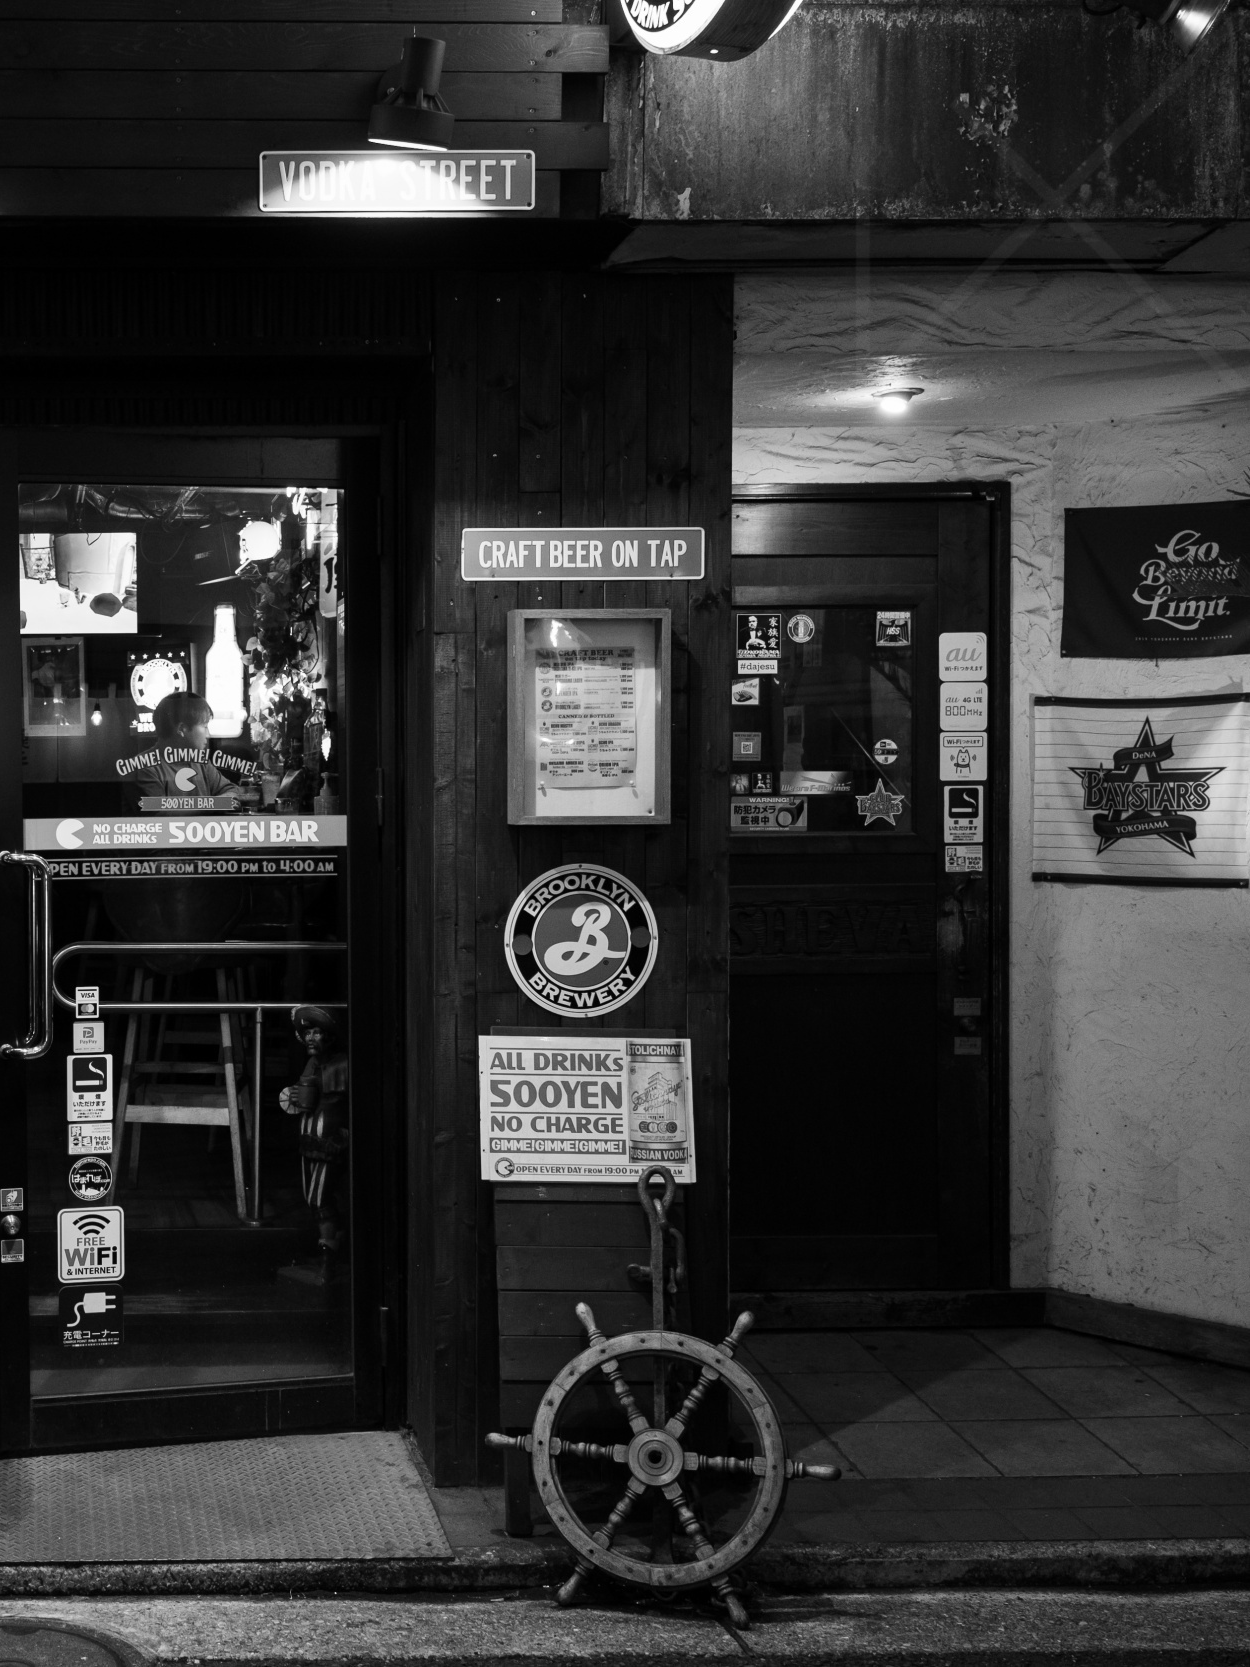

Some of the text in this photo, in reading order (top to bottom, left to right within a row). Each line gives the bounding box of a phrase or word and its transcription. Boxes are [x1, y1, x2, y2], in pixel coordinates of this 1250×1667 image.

[630, 1, 669, 29] DRINK
[279, 159, 517, 201] VODKA STREET
[479, 539, 688, 568] CRAFT BEER ON TAP
[1155, 530, 1219, 562] Go
[946, 648, 982, 662] au
[740, 663, 775, 672] #dajesu
[116, 746, 257, 776] GIMME! GIMME! GIMME!
[1132, 751, 1156, 760] DeNA
[1082, 769, 1210, 811] BAYSTARS
[161, 798, 215, 809] 500YEN BAR
[733, 805, 777, 815] 防犯カメラ
[740, 816, 770, 825] 監視中
[1116, 820, 1169, 834] YOKOHAMA
[93, 823, 162, 834] NO CHARGE
[169, 820, 319, 843] 500YEN BAR
[93, 834, 111, 844] ALL
[49, 863, 79, 876] PEN
[82, 862, 128, 875] EVERY
[131, 861, 158, 875] DAY
[161, 863, 194, 874] FROM
[198, 860, 238, 873] 19:00
[241, 863, 259, 873] PM
[280, 860, 315, 872] 4:00
[316, 862, 334, 872] AM
[523, 874, 636, 917] BROOKLYN
[529, 966, 637, 1008] BREWERY
[490, 1052, 525, 1070] ALL
[490, 1079, 623, 1109] 500YEN
[490, 1115, 624, 1134] NO CHARGE
[662, 1151, 687, 1160] VODKA
[516, 1165, 538, 1173] OPEN
[540, 1166, 566, 1174] EVERY
[567, 1166, 582, 1174] DAY
[604, 1166, 627, 1175] 19:00
[77, 1236, 106, 1247] FREE
[64, 1246, 118, 1267] WiFi
[74, 1266, 117, 1275] INTERNET
[63, 1329, 119, 1340] 充電コーナー
